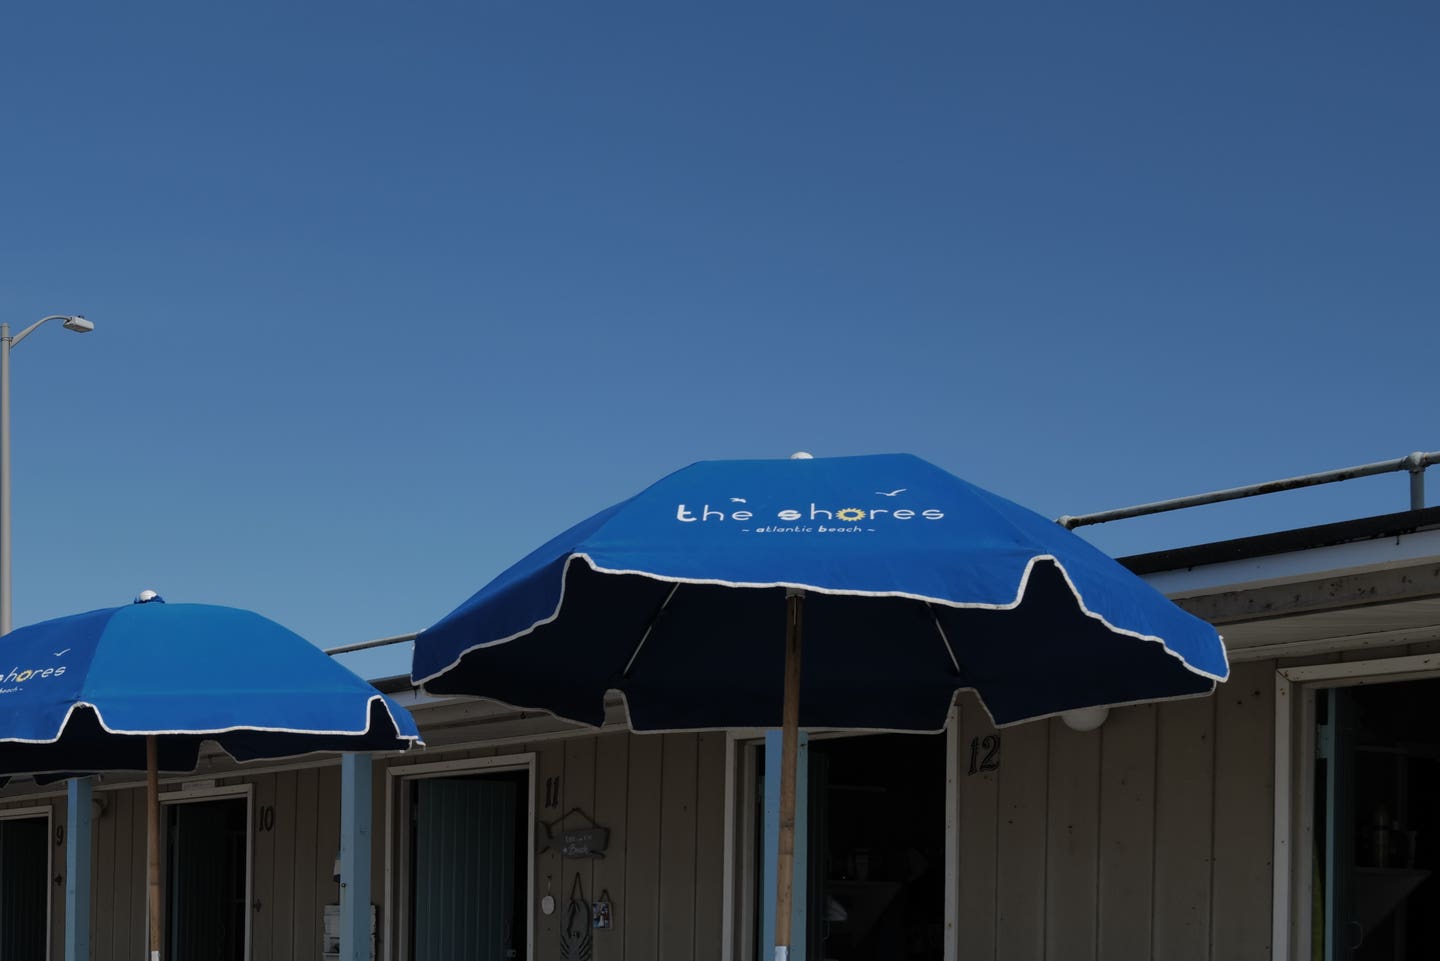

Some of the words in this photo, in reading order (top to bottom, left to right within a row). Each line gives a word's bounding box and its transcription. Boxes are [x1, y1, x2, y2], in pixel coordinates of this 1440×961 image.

[677, 504, 754, 522] the
[777, 503, 945, 522] shores
[756, 525, 813, 533] atlantic
[818, 525, 862, 533] beach
[968, 735, 1001, 776] 12
[545, 775, 560, 809] 11
[259, 805, 274, 832] 10
[56, 825, 64, 846] 9
